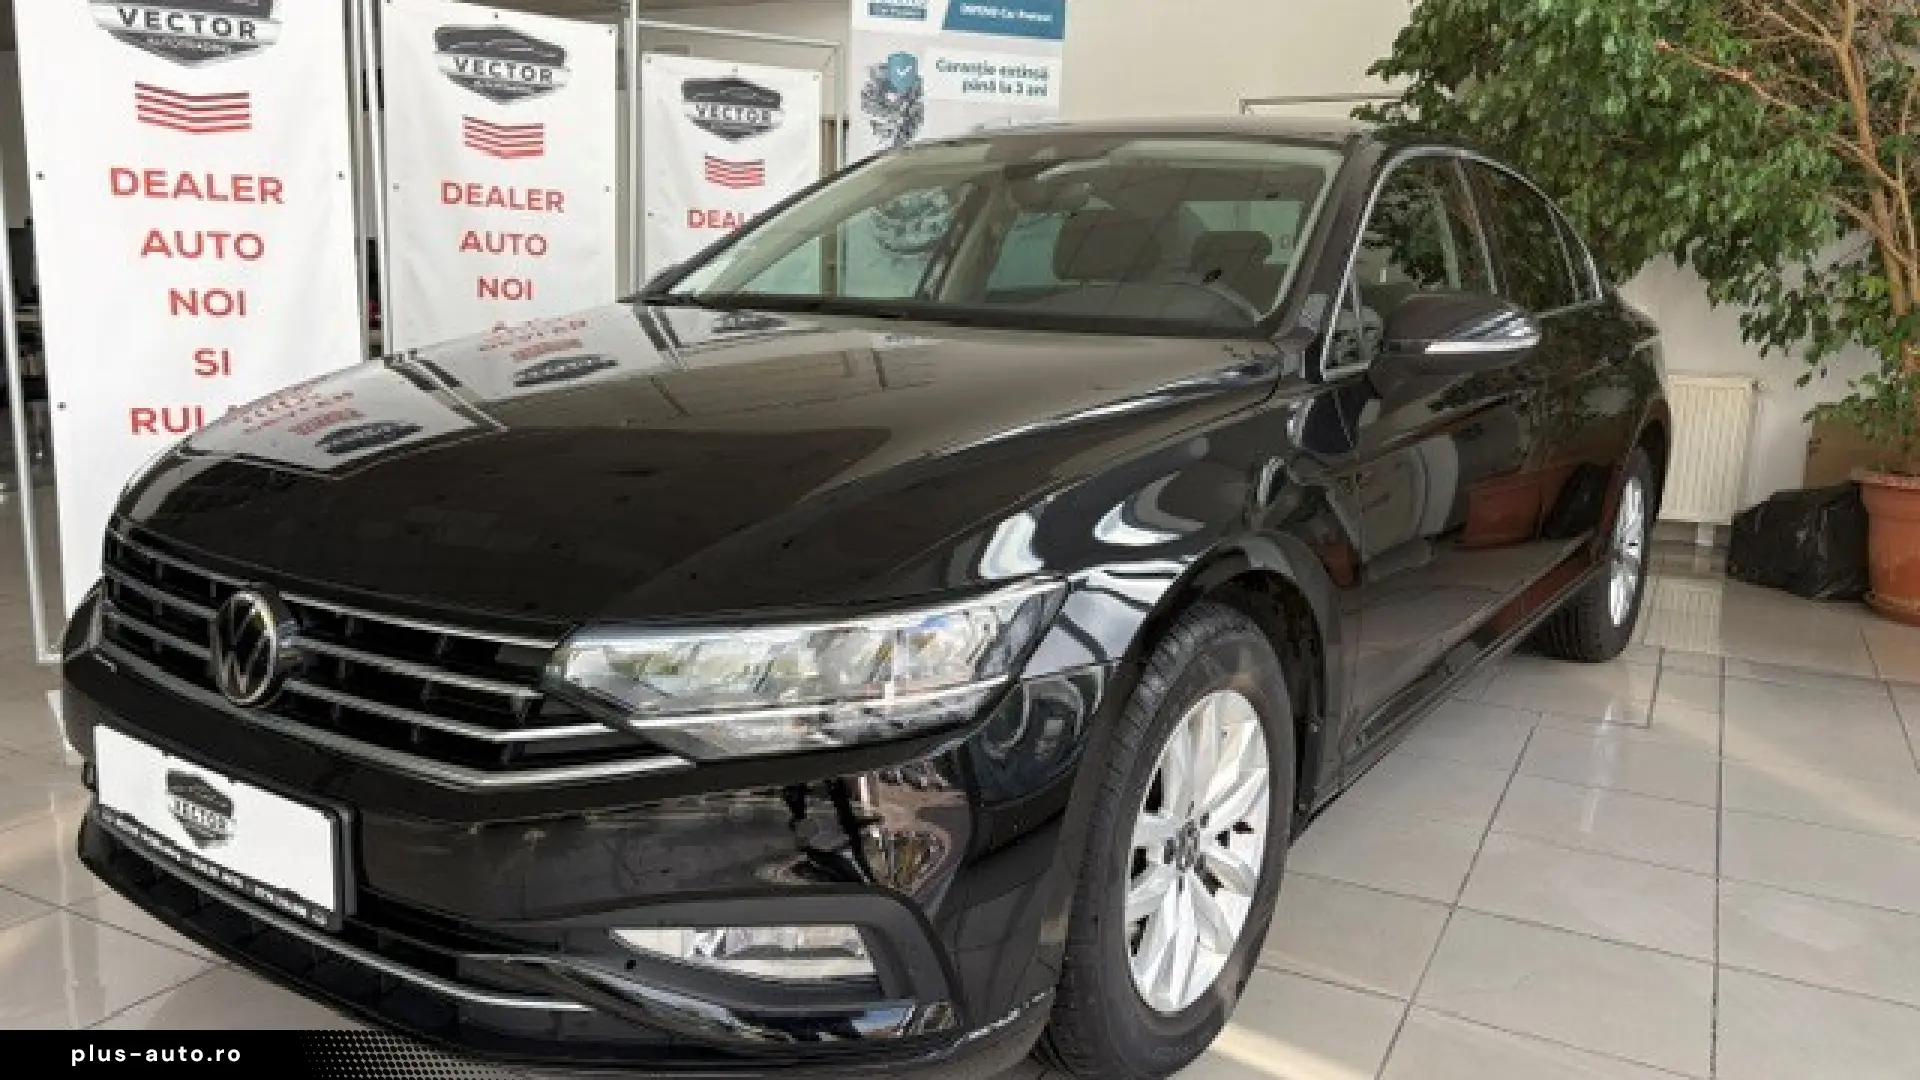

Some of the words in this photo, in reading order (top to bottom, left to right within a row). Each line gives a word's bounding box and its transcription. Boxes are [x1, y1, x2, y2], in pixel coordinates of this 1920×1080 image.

[118, 8, 257, 40] VECTOR
[454, 57, 553, 84] VECTOR
[696, 103, 772, 123] VECTOR
[110, 167, 284, 204] DEALER
[441, 181, 565, 213] DEALER
[687, 209, 757, 231] DEAL
[141, 229, 264, 261] AUTO
[459, 230, 548, 257] AUTO
[169, 288, 247, 317] NOI
[477, 276, 532, 301] NOI
[194, 348, 231, 376] SI
